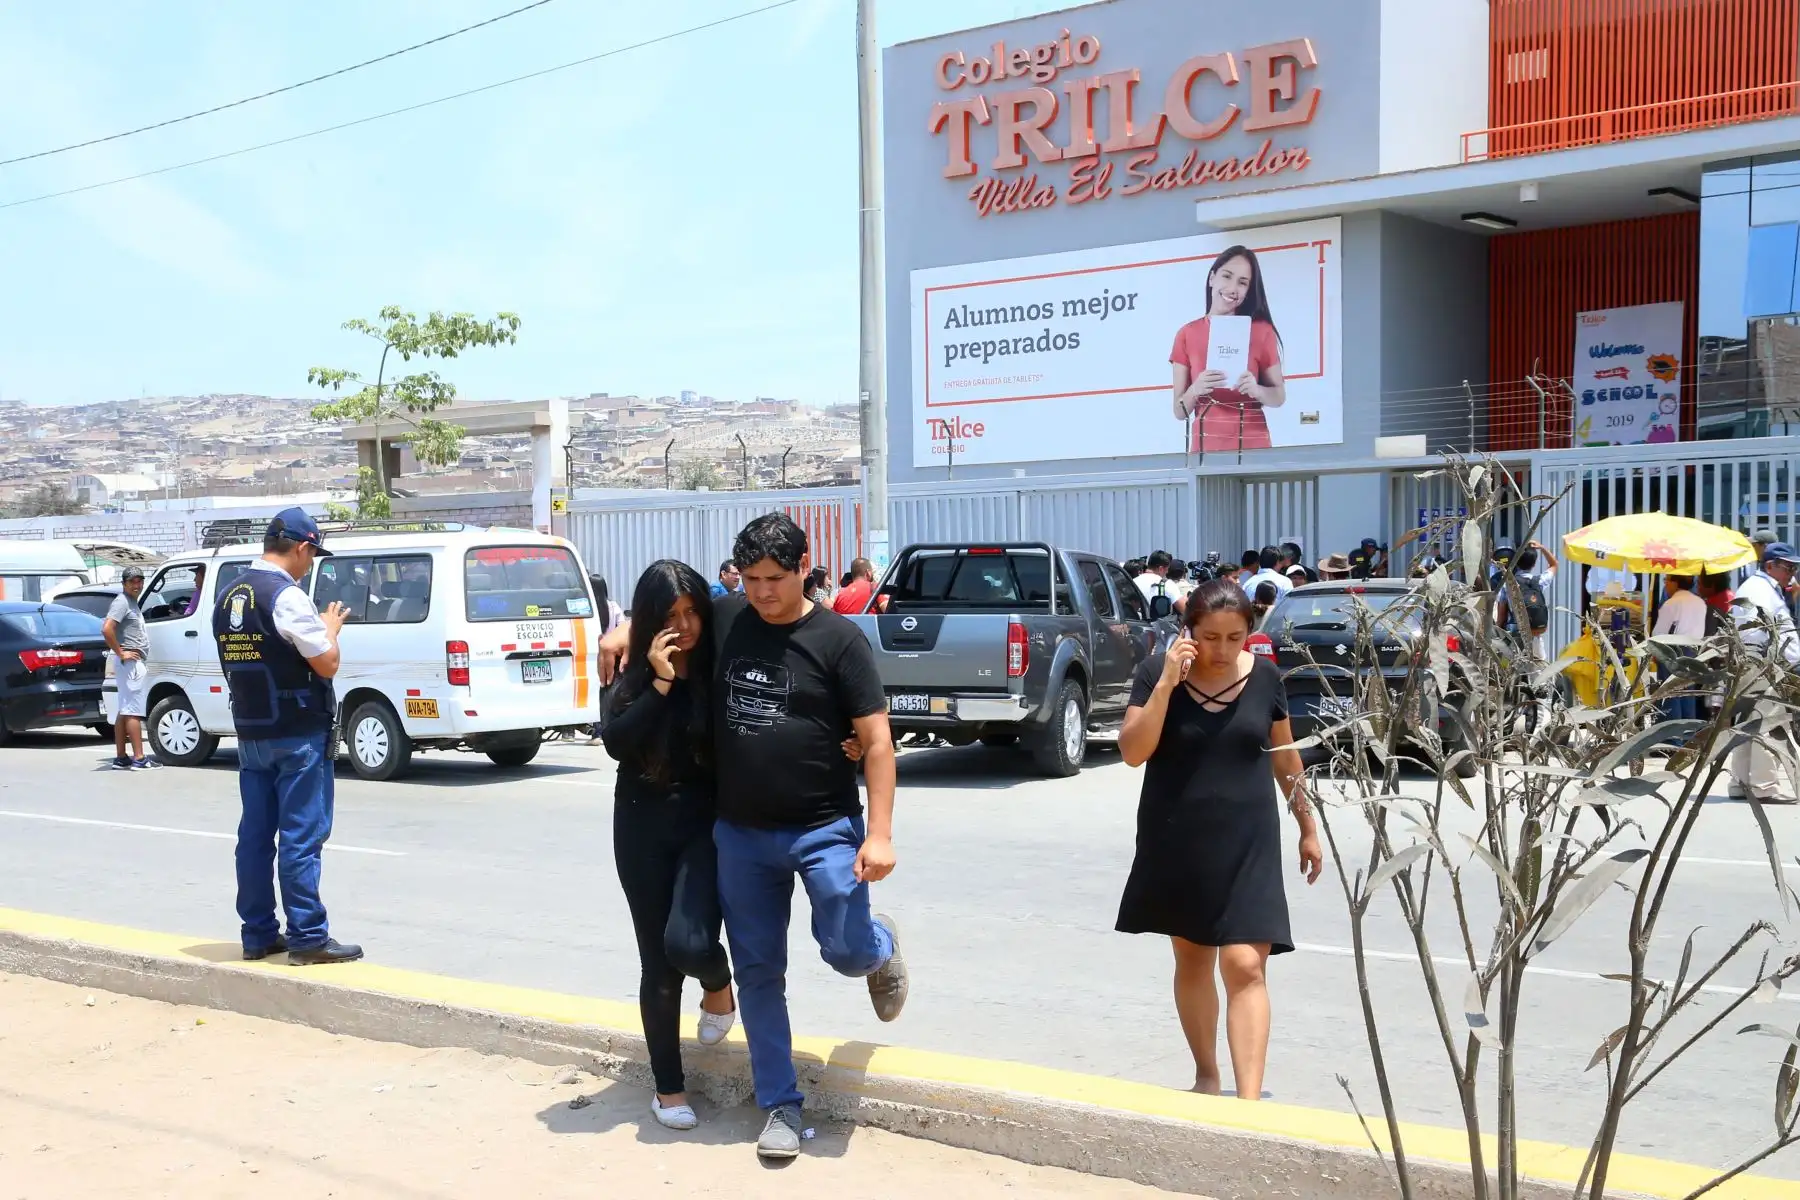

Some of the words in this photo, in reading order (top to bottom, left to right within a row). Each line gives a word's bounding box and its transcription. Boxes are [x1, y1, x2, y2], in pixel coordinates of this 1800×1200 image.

[935, 28, 1100, 90] Colegio
[928, 37, 1321, 178] TRILCE
[968, 175, 1057, 216] Villa
[1066, 157, 1112, 204] El
[1119, 139, 1312, 196] Salvador
[943, 301, 1054, 330] Alumnos
[1062, 288, 1138, 321] mejor
[943, 328, 1081, 368] preparados
[944, 380, 971, 389] ENTREGA
[972, 378, 1002, 387] GRATUITA
[1581, 383, 1658, 406] SCHOOL
[926, 415, 985, 440] Trilce
[1605, 414, 1634, 428] 2019
[516, 622, 554, 632] SERVICIO
[252, 633, 263, 641] DE
[517, 631, 554, 639] ESCOLAR
[224, 651, 262, 661] SUPERVISOR
[524, 665, 550, 679] AVA-794
[407, 703, 436, 715] AVA-794
